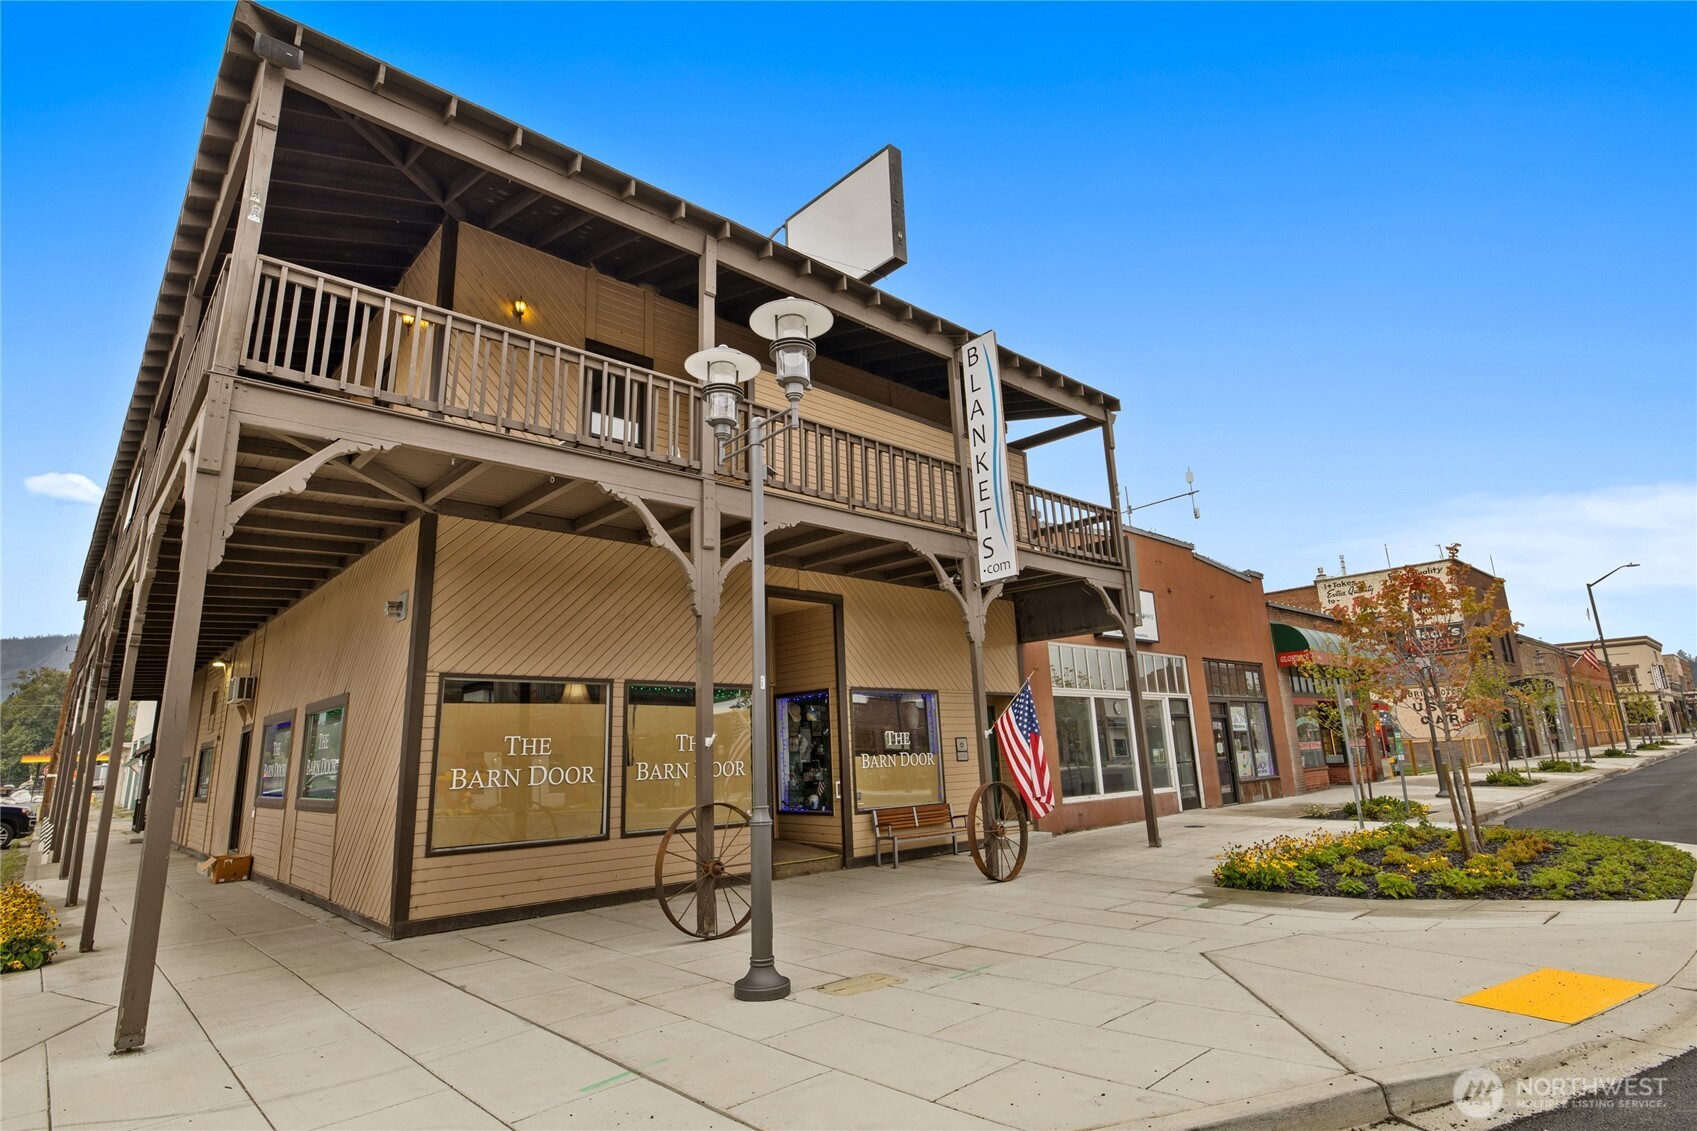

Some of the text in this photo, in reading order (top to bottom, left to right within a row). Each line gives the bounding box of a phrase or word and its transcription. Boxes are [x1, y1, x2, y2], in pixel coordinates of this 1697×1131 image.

[967, 346, 995, 560] BLANKETS
[982, 558, 1011, 574] .com
[503, 735, 552, 757] THE
[885, 730, 911, 746] THE
[635, 760, 747, 781] BARN OOR
[861, 751, 935, 769] BARN DOOR
[449, 764, 596, 790] BARN DOOR
